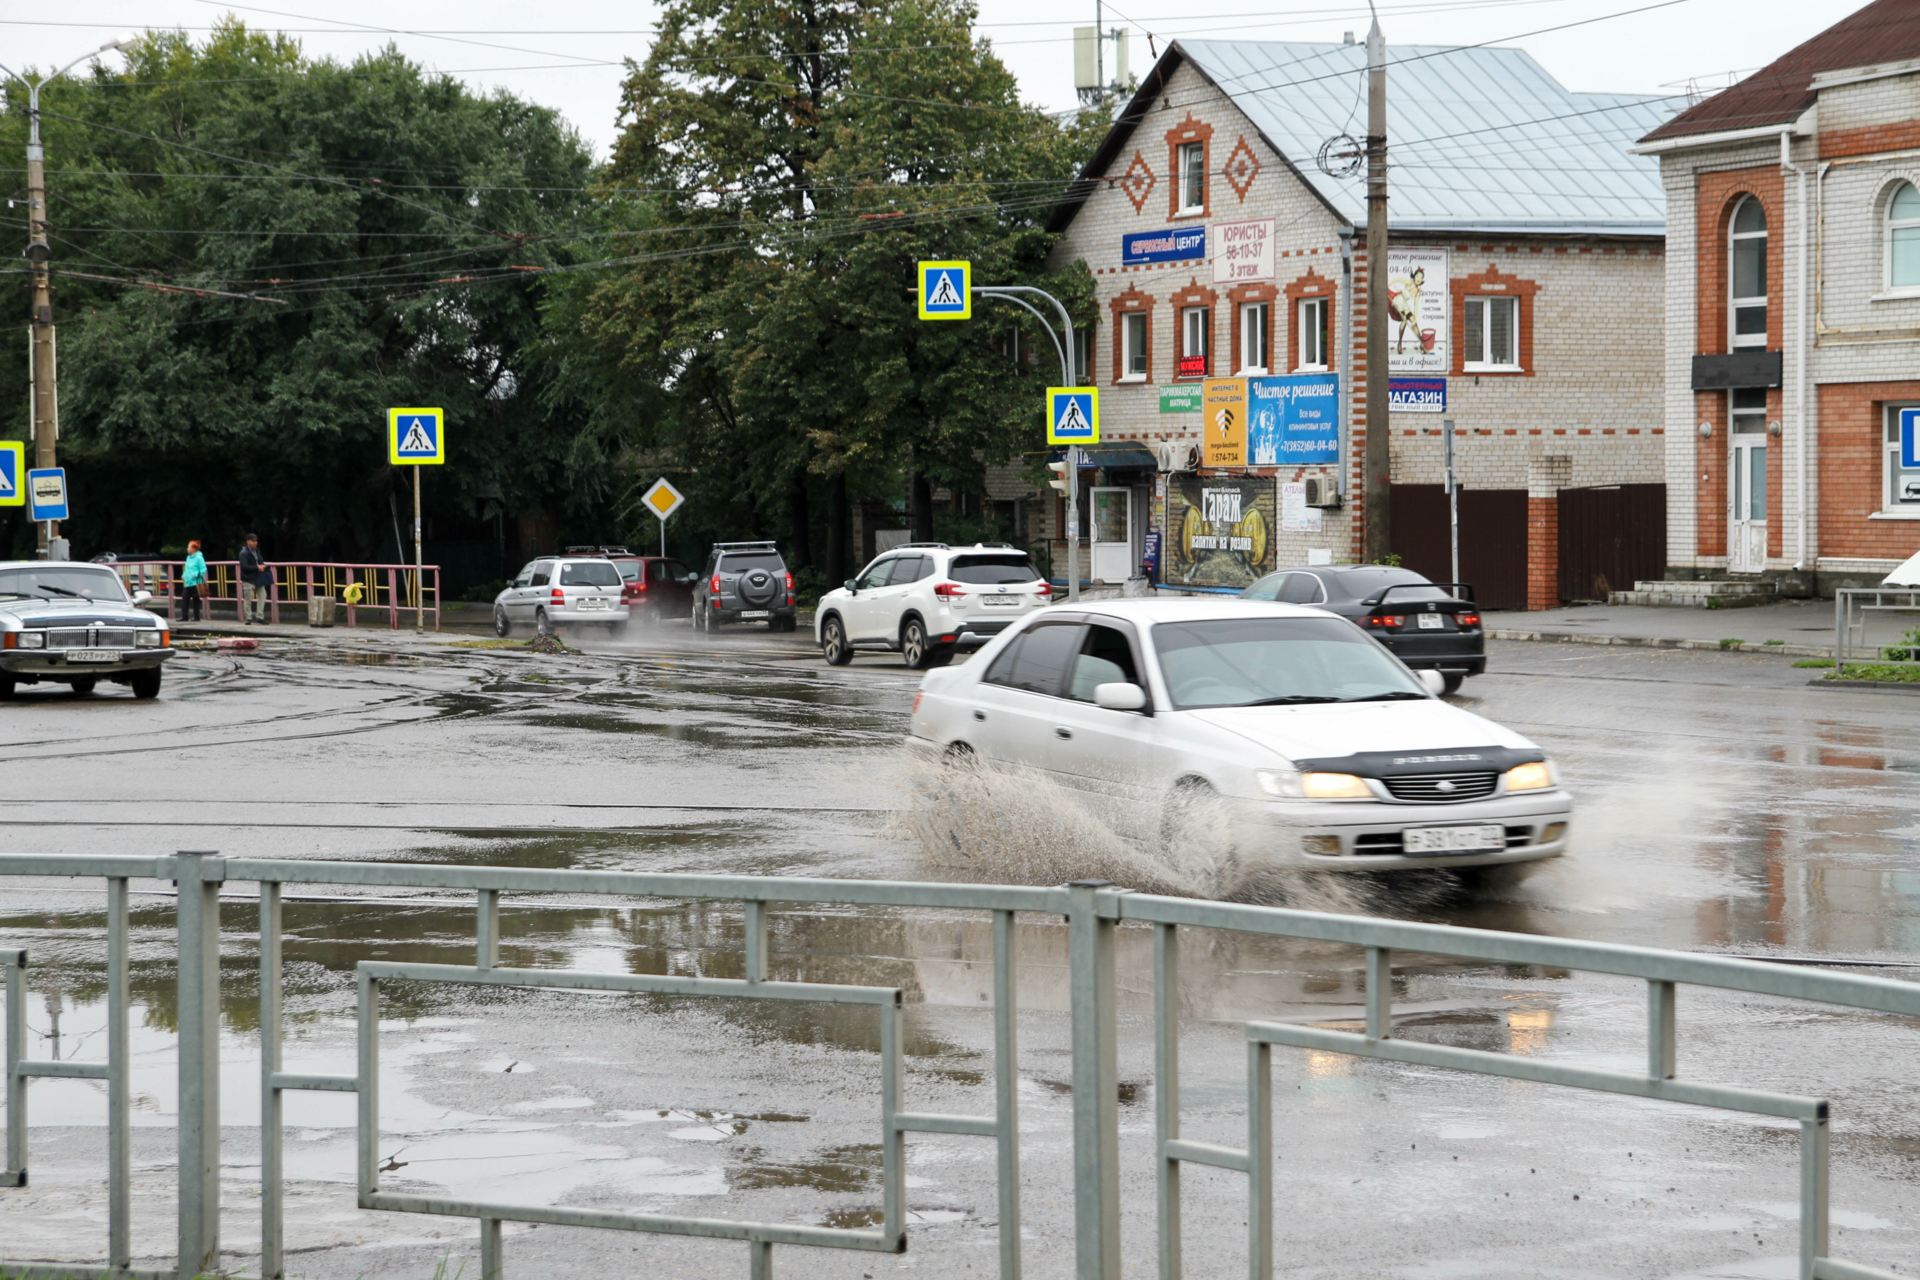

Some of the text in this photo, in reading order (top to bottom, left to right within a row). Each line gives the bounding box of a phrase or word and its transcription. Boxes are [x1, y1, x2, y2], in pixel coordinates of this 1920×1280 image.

[1224, 223, 1266, 242] ЮРИСТЫ
[1131, 235, 1200, 254] СЕРВИСНЫЙ ЦЕНТР
[1230, 262, 1258, 278] 3 этаж
[1160, 386, 1202, 397] ПАРИКМАХЕРСКАЯ
[1253, 381, 1334, 405] Чистое решение
[1169, 398, 1191, 408] МАТРИЦА
[1299, 409, 1321, 418] Все виды
[1288, 422, 1332, 432] клининговых услуг
[1280, 440, 1337, 453] +7(3852)60-04-60
[1215, 452, 1238, 461] 574-734
[1202, 487, 1242, 528] Гараж
[1191, 535, 1252, 551] напитки на розлив
